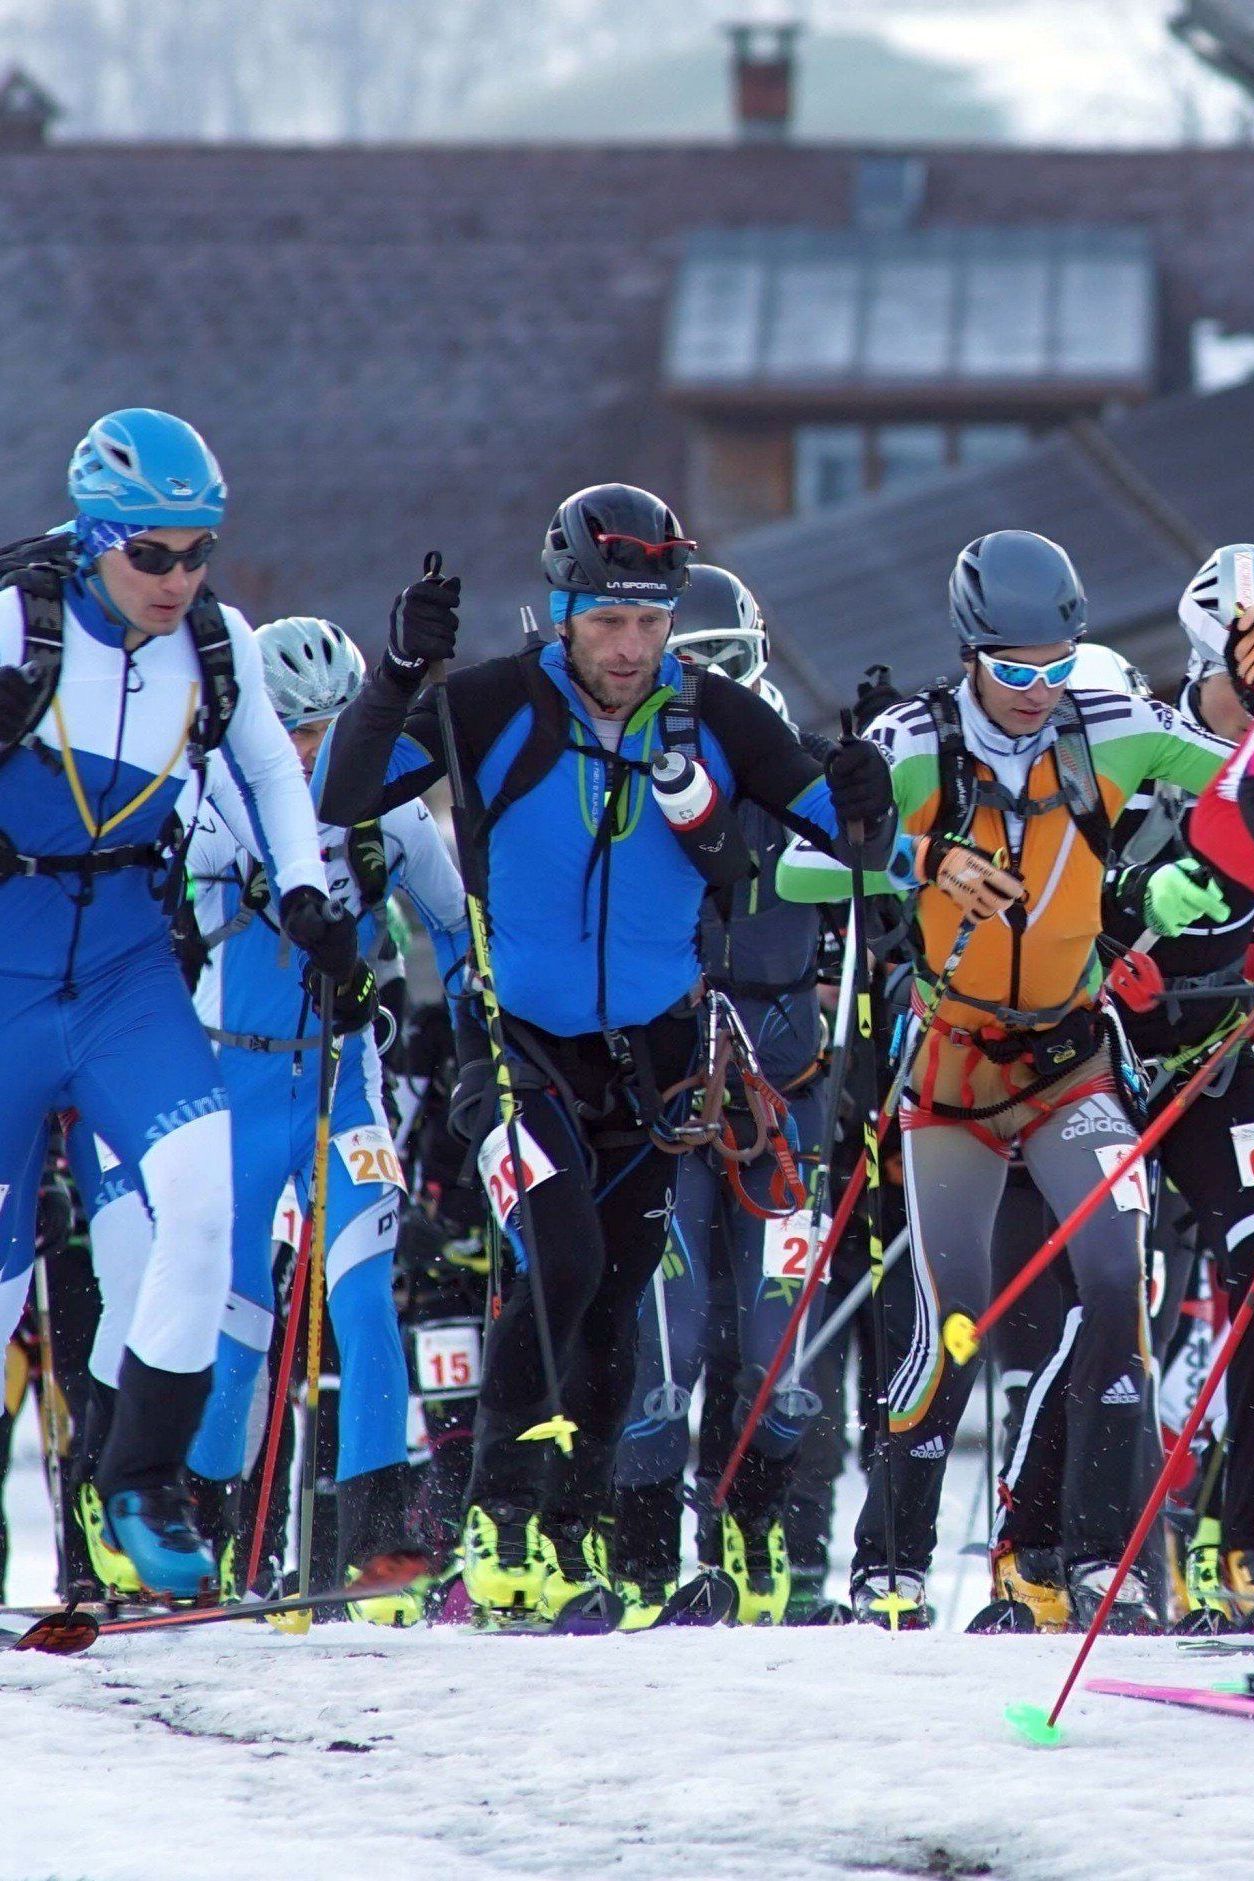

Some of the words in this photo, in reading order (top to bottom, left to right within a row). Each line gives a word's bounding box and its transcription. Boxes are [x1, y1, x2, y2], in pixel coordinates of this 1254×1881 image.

[622, 582, 668, 590] SPORTIVA
[1060, 1116, 1139, 1141] adidas
[349, 1148, 399, 1183] 20
[431, 1351, 472, 1387] 15
[1100, 1394, 1141, 1405] adidas
[910, 1448, 945, 1460] adidas
